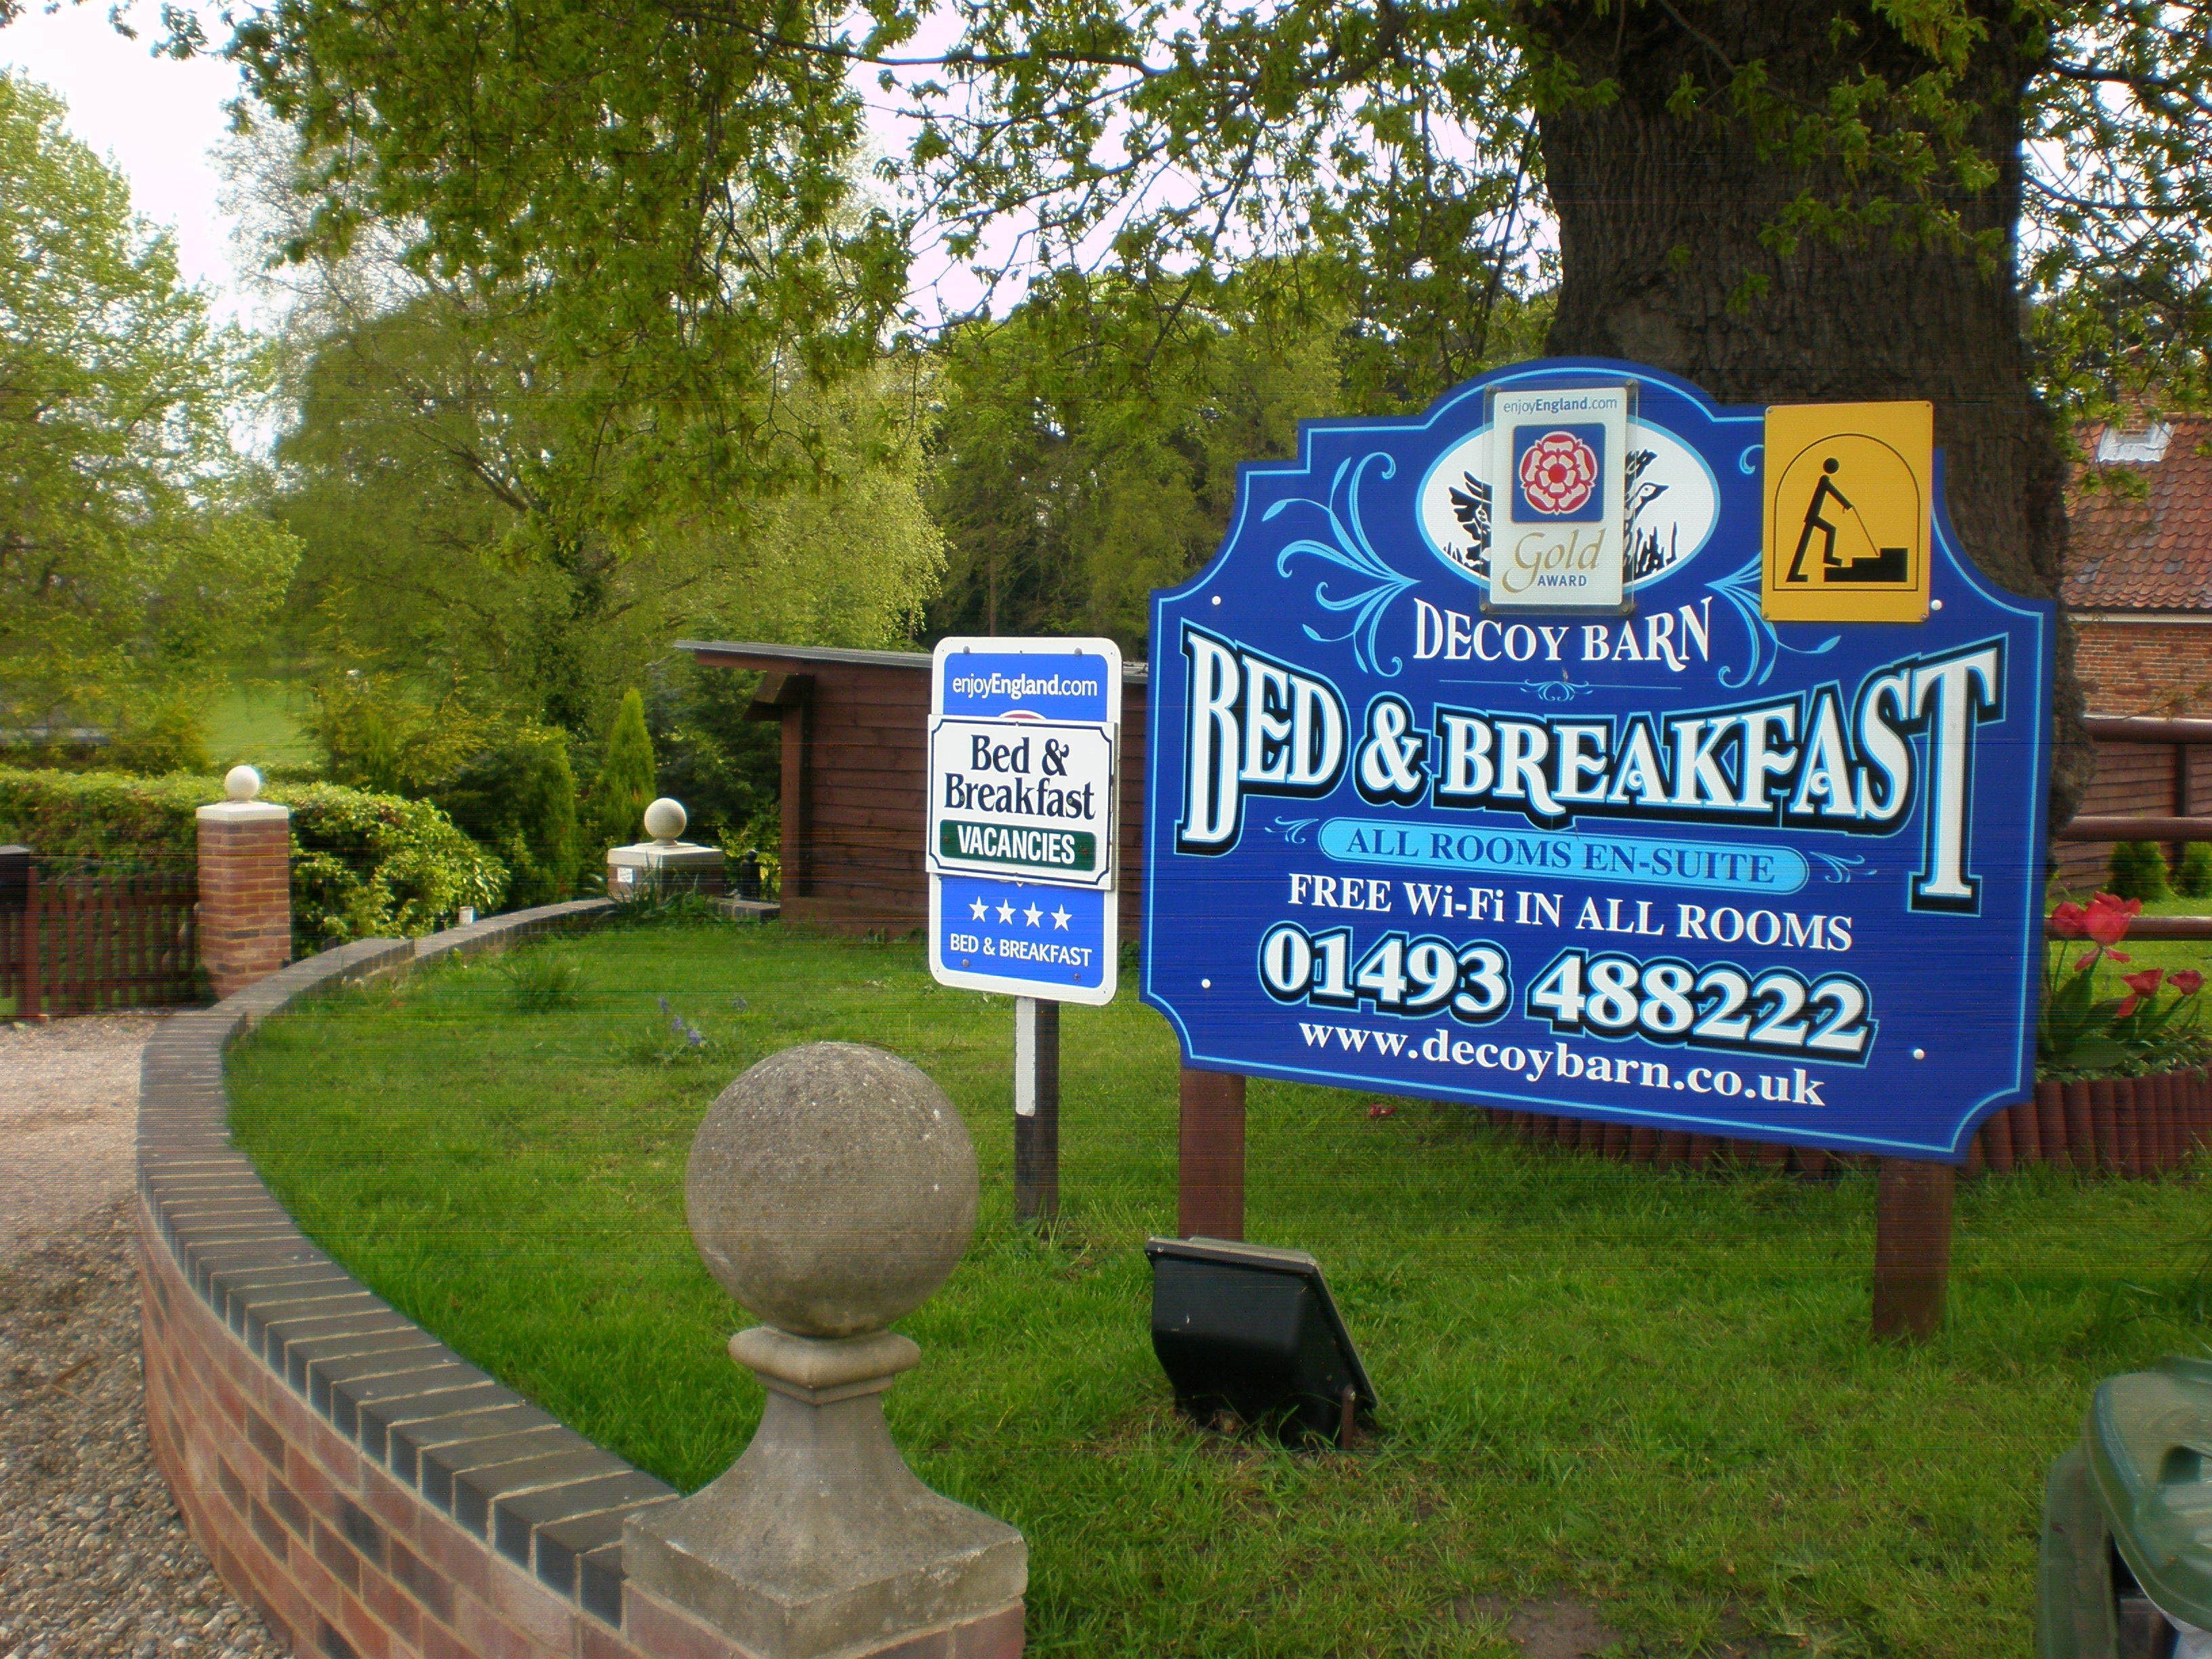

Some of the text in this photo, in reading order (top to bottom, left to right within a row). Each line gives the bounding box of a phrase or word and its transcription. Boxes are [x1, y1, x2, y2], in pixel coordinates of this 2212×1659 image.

[1503, 396, 1617, 414] enjoyEngland.com
[1502, 527, 1607, 594] Gold
[1537, 576, 1588, 588] AWARD
[1413, 596, 1712, 671] DECOY BARN
[952, 673, 1098, 699] enjoyEngland.com
[970, 735, 1070, 776] Bed &
[1181, 632, 1999, 899] BED & BREAKFAST
[944, 773, 1097, 820] Breakfast
[958, 825, 1076, 864] VACANCIES
[1346, 827, 1776, 884] ALL ROOMS EN-SUITE
[1288, 874, 1853, 951] FREE Wi-Fi IN ALL ROOMS
[950, 934, 1092, 966] BED & BREAKFAST
[1265, 928, 1868, 1052] 01493 488222
[1298, 1022, 1826, 1106] www.decoybarn.co.uk
